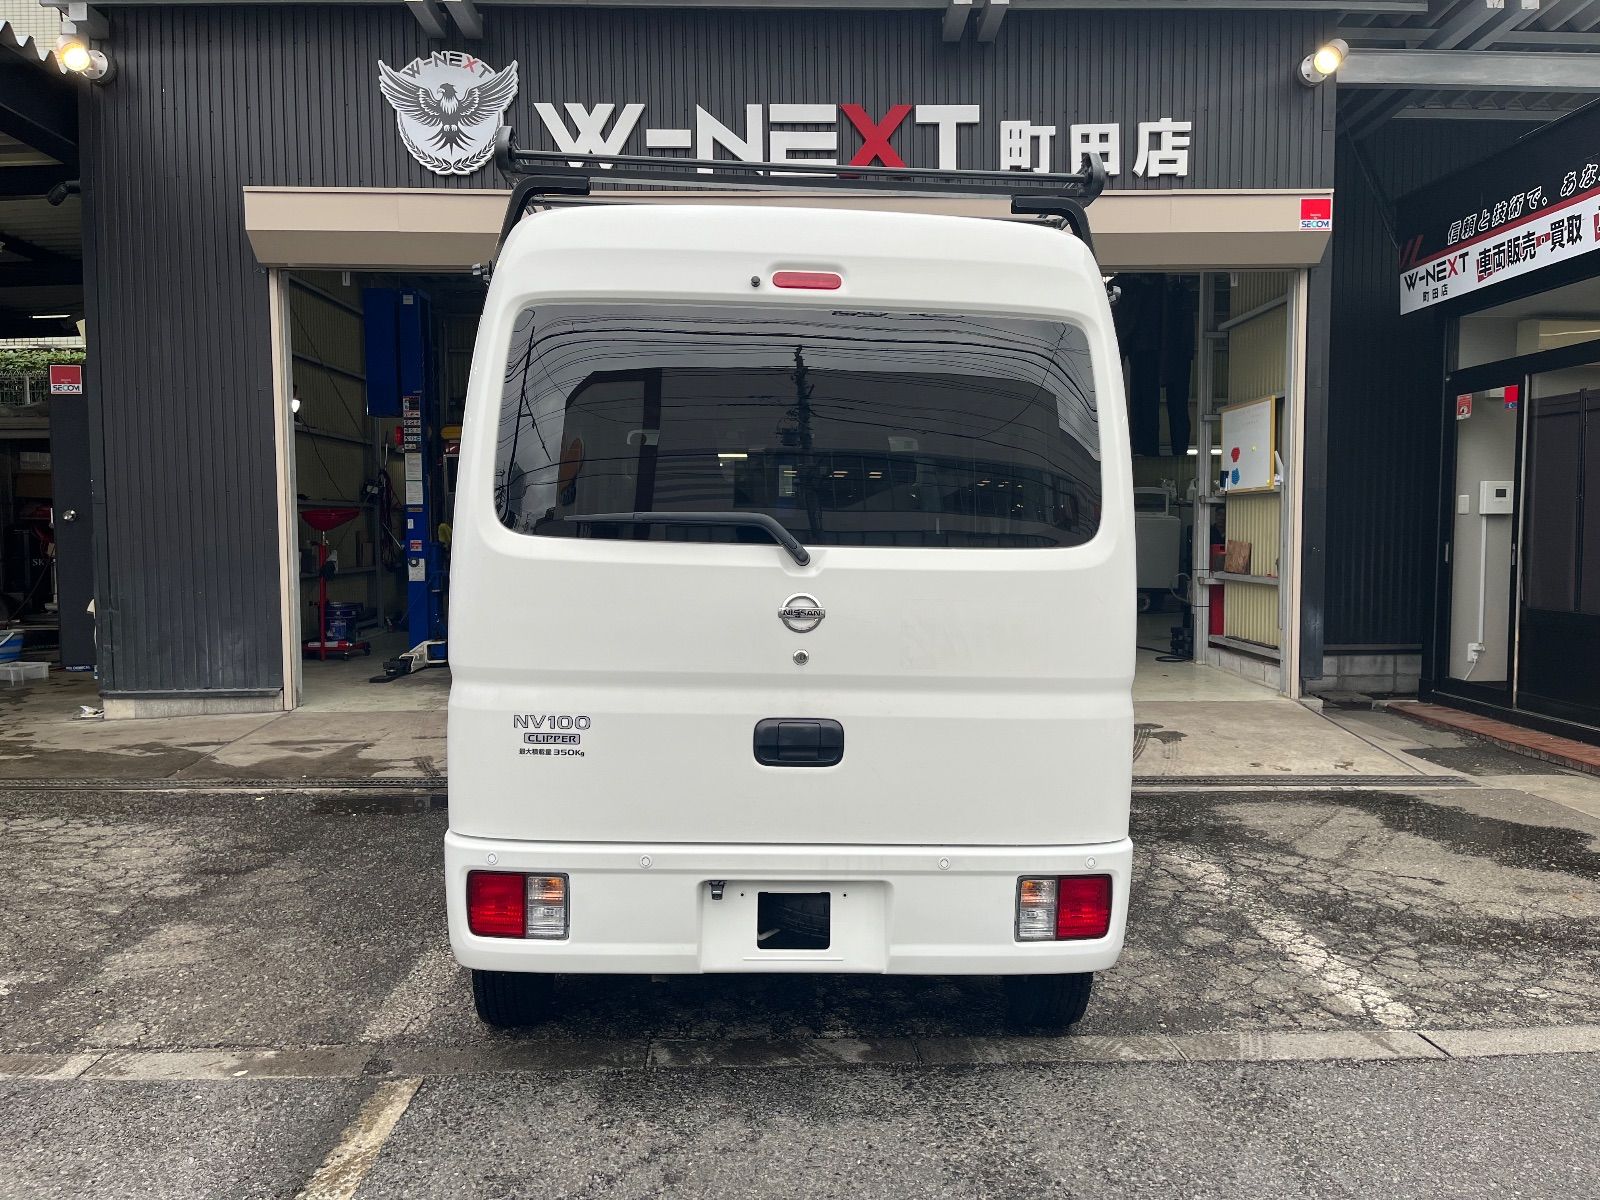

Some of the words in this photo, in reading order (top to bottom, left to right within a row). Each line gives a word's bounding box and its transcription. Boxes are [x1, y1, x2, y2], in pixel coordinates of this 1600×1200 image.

[402, 52, 492, 79] W-NEXT
[534, 103, 980, 178] W-NEXT
[1001, 118, 1192, 177] 町田店
[1448, 164, 1600, 245] 信頼と技術で。あな
[1404, 251, 1469, 292] W-NEXT
[1423, 283, 1449, 303] 町田店
[783, 609, 820, 617] NISSAN
[513, 714, 591, 730] NV100
[527, 734, 577, 743] CLIPPER
[553, 749, 585, 757] 350Kg
